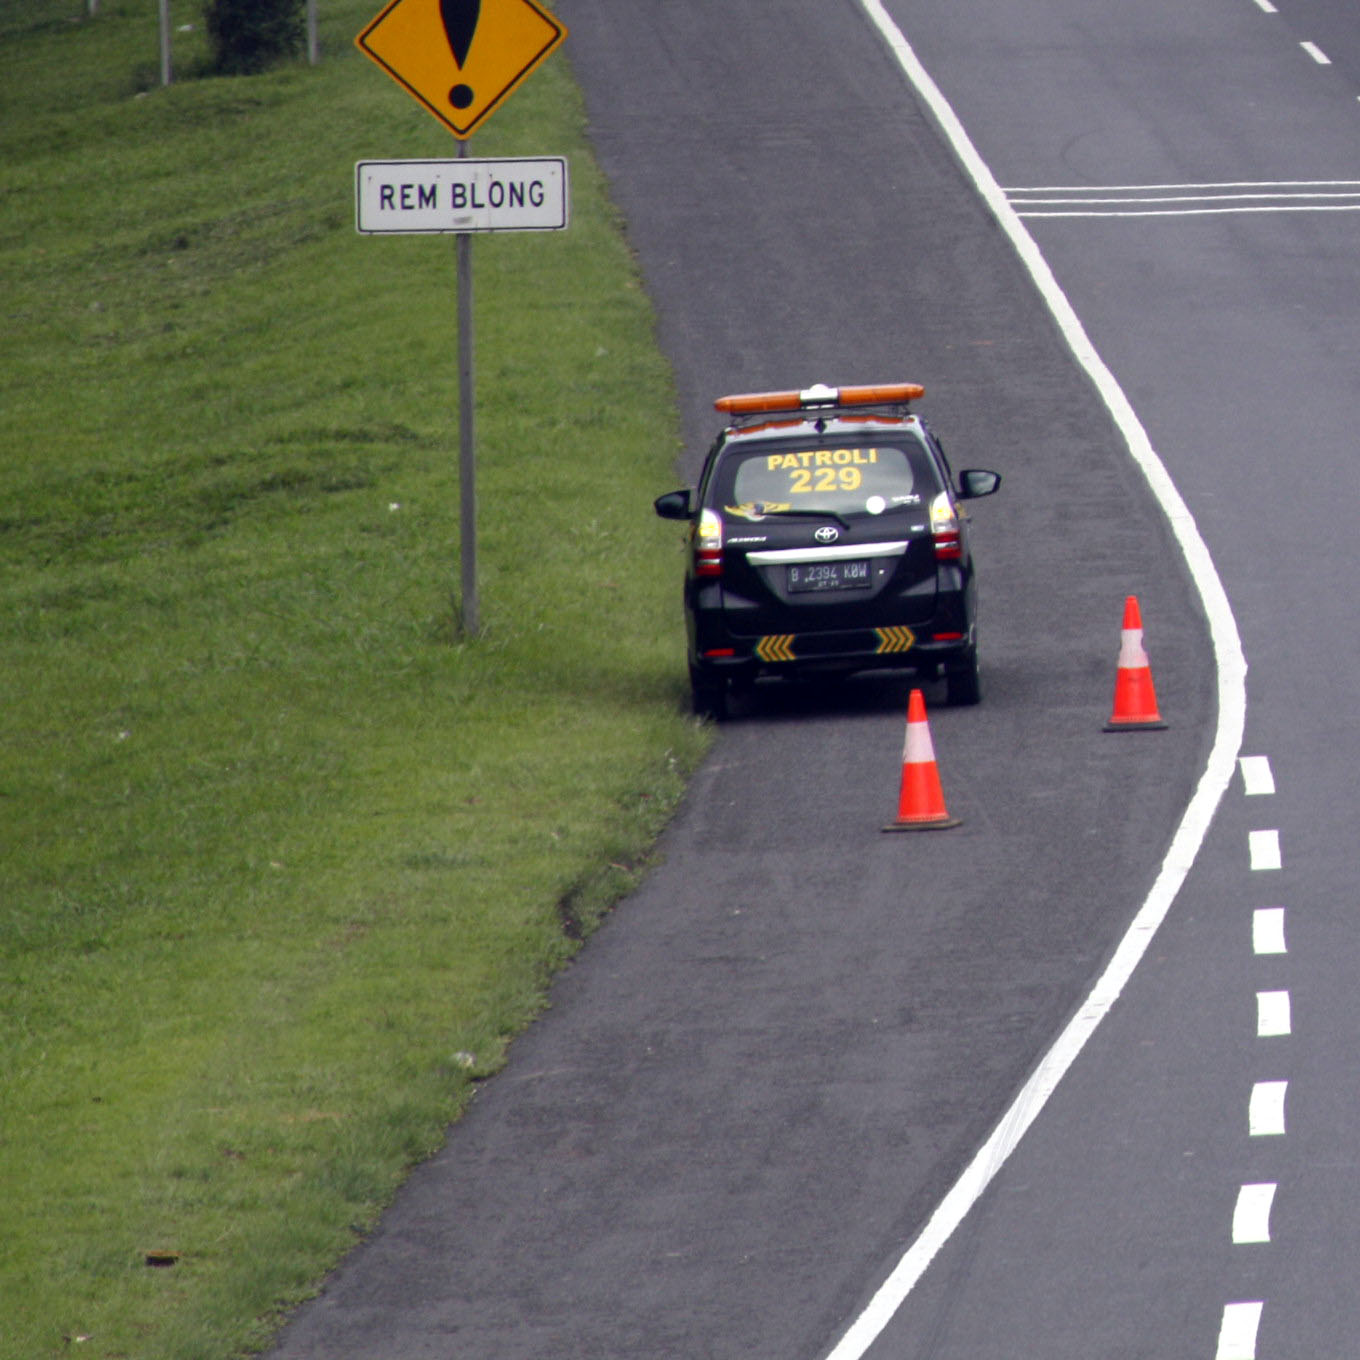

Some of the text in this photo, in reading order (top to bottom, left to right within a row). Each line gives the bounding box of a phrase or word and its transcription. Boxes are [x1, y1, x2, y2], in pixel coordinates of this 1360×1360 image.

[380, 180, 545, 211] REM BLONG
[766, 447, 878, 470] PATROLI
[789, 466, 862, 493] 229
[791, 567, 799, 582] B
